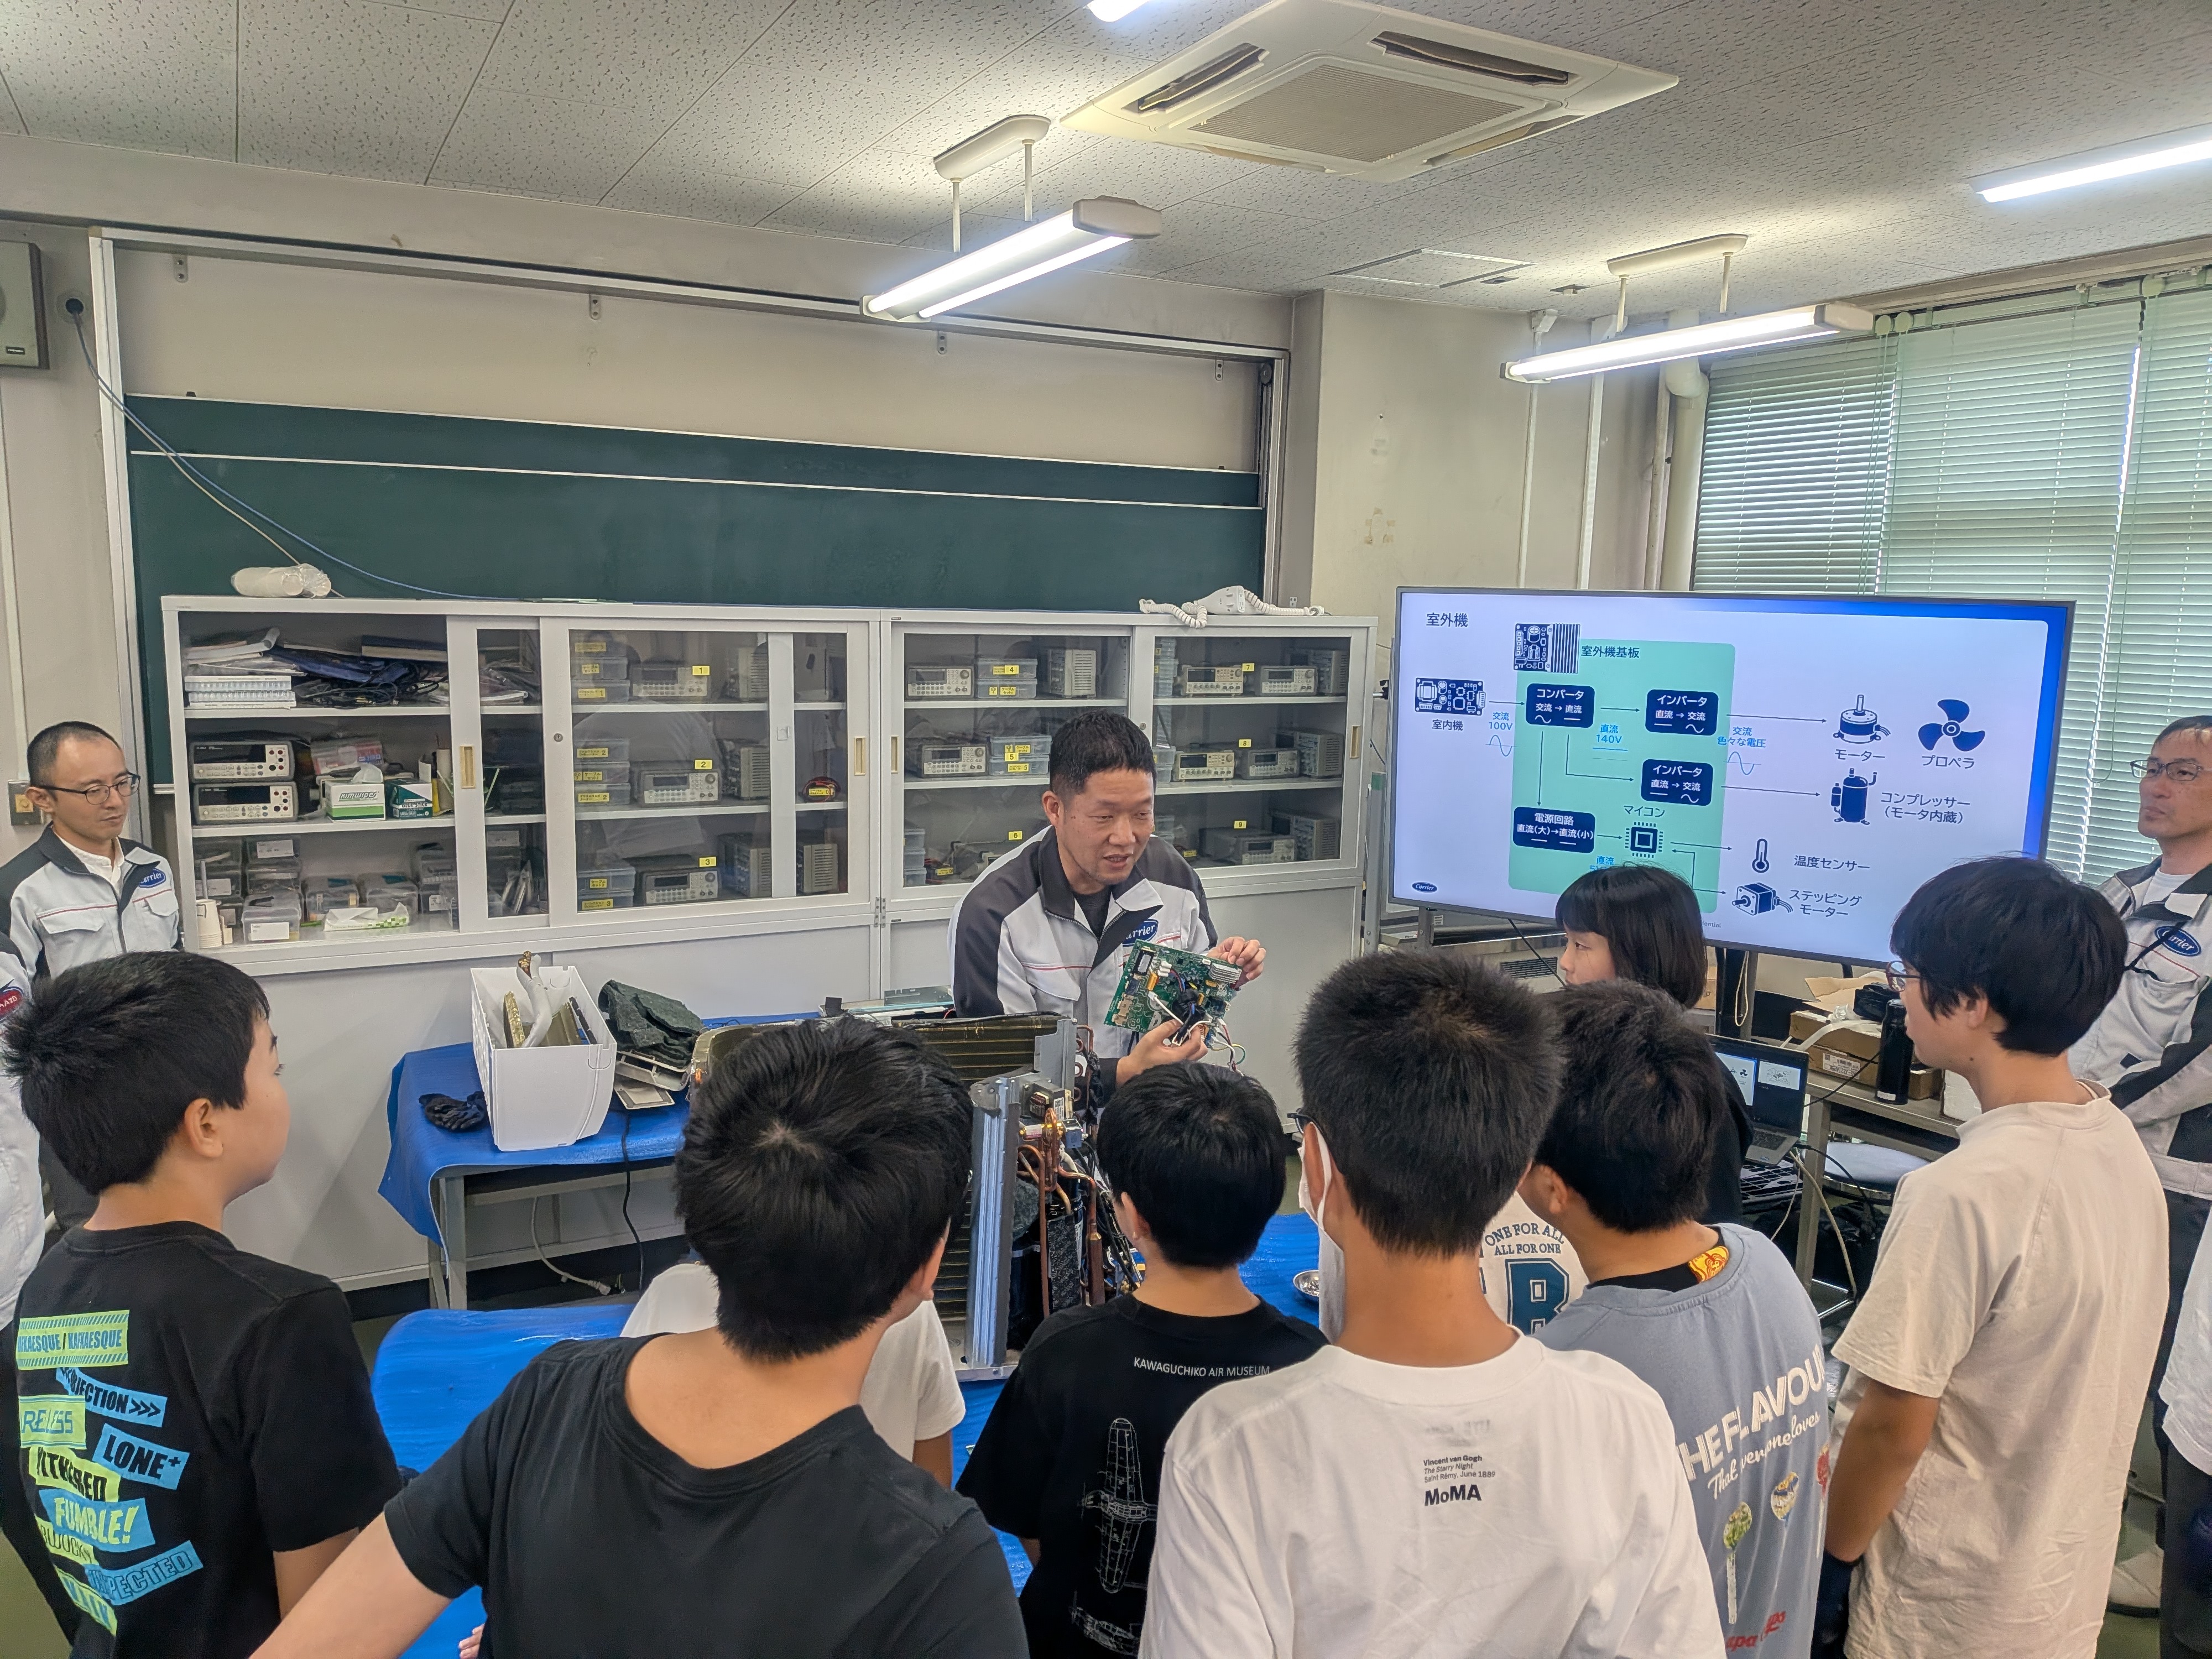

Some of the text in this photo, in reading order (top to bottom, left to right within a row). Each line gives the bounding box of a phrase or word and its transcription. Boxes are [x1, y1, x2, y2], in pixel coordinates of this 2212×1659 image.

[1426, 612, 1468, 628] 室外機
[1581, 645, 1640, 659] 室外機基板
[1657, 695, 1707, 707] インバータ
[1535, 702, 1582, 714] 交流 直流
[1493, 712, 1510, 721] 交流
[1655, 709, 1706, 721] 直流 交流
[1432, 719, 1463, 731] 室内機
[1489, 721, 1513, 731] 100V
[1600, 724, 1619, 734] 直流
[1732, 726, 1752, 736] 交流
[1595, 734, 1623, 744] 140V
[1717, 736, 1766, 748] 色々な電圧
[1834, 749, 1885, 762] モーター
[1922, 754, 1975, 770] プロペラ
[1652, 764, 1703, 777] インバータ
[1651, 779, 1701, 791] 直流 交流
[1880, 792, 1970, 808] コンプレッサー
[1623, 805, 1666, 818] マイコン
[1534, 812, 1574, 826] 電源回路
[1597, 855, 1615, 865] 直流
[1793, 854, 1871, 872] 温度センサー
[140, 872, 162, 884] arrier
[1788, 889, 1863, 906] ステッピング
[1799, 904, 1849, 917] モーター
[1484, 1223, 1564, 1246] ONE FOR ALL
[1494, 1243, 1561, 1256] ALL FOR ONE
[1134, 1357, 1271, 1377] KAWAGUCHIKO AIR MUSEUM
[1676, 1424, 1724, 1481] HE
[1707, 1458, 1739, 1500] That
[1791, 1411, 1821, 1438] loves
[1423, 1457, 1448, 1466] Vincent
[1436, 1465, 1454, 1473] Starry
[1424, 1475, 1439, 1483] Saint
[1424, 1484, 1482, 1506] MoMA
